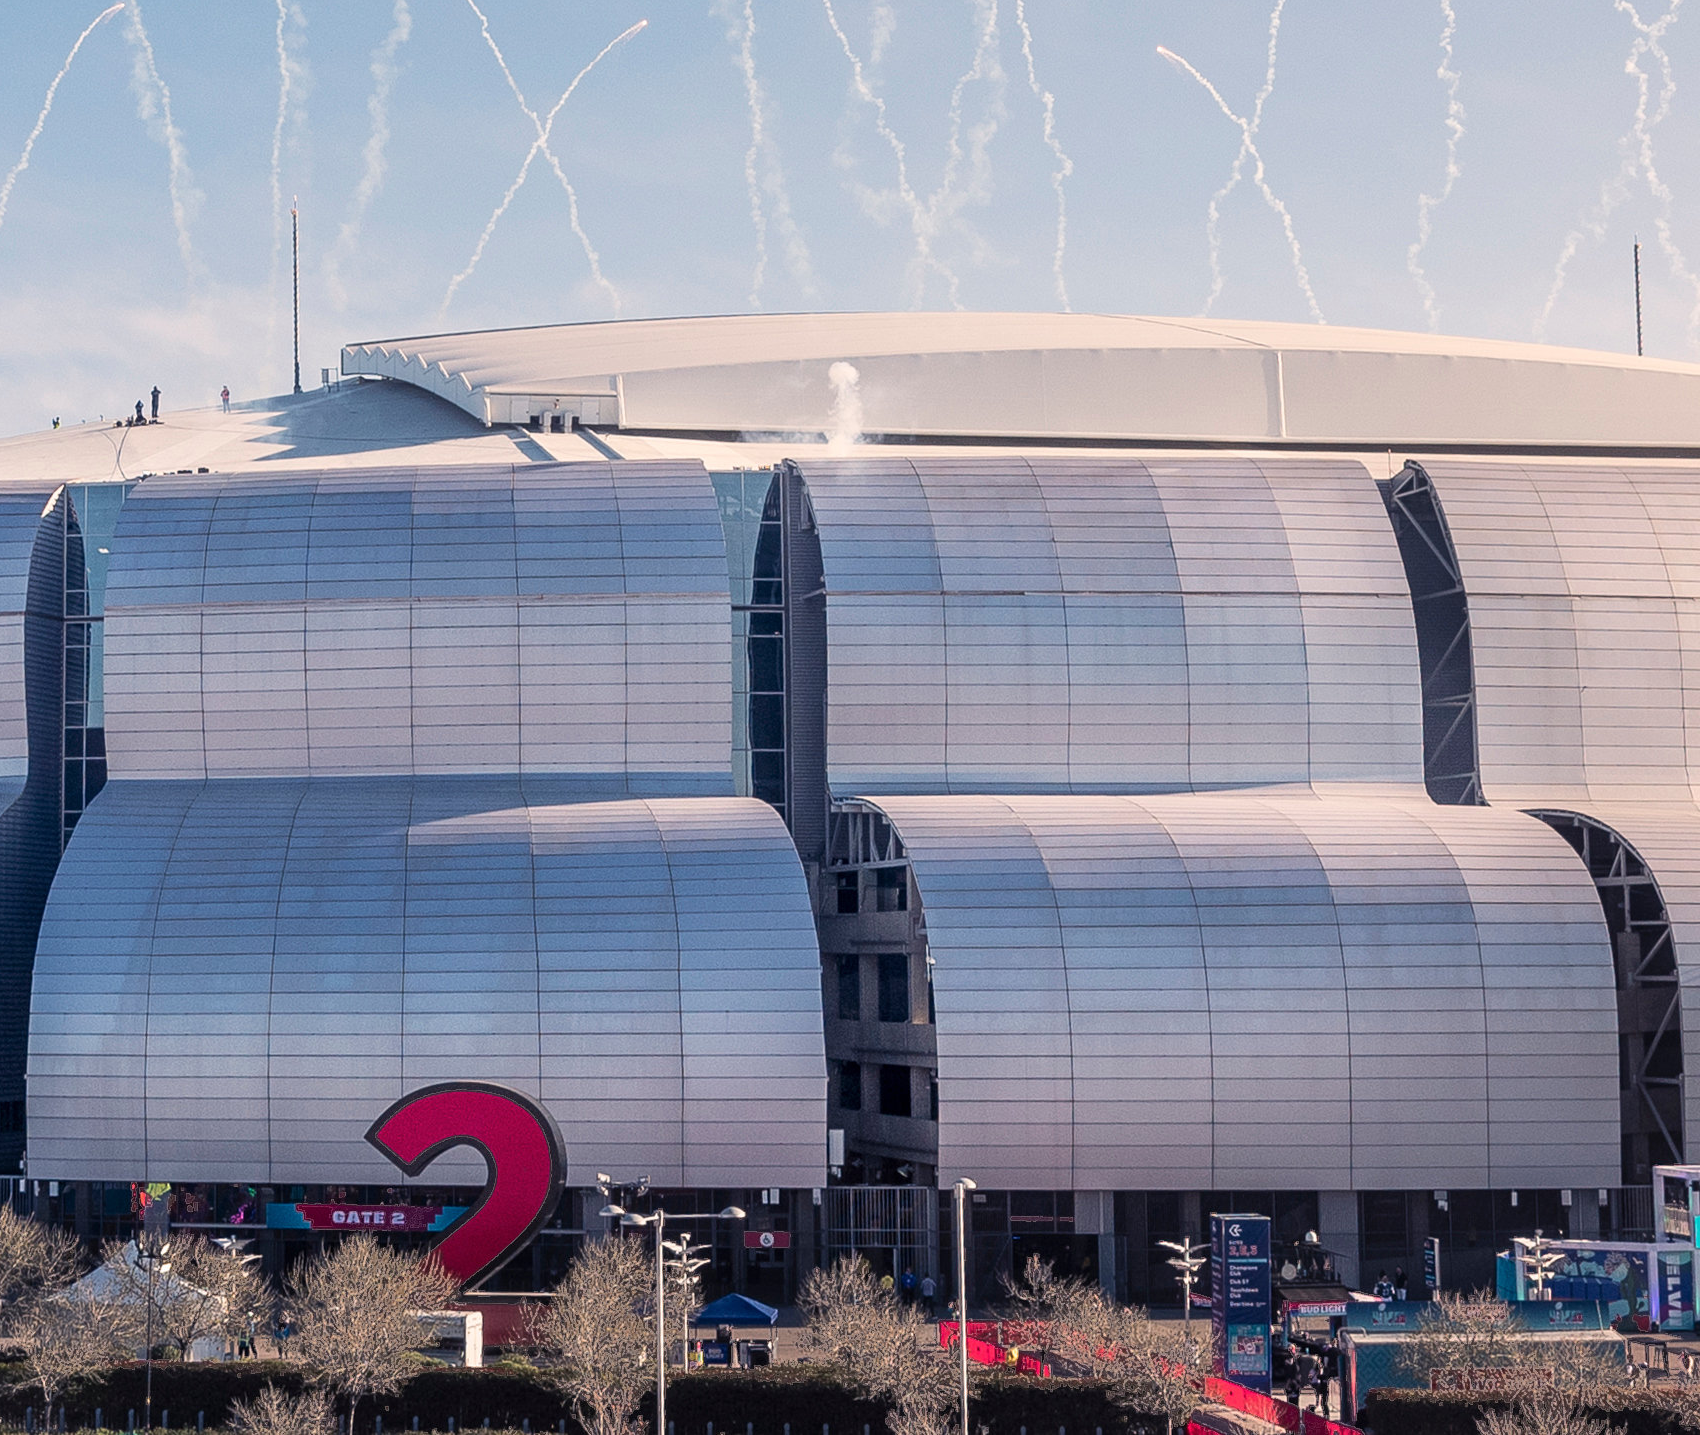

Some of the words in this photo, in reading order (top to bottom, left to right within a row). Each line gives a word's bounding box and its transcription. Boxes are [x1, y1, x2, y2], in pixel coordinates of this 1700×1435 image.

[332, 1210, 385, 1224] GATE
[392, 1211, 405, 1224] 2
[363, 1080, 568, 1348] 2
[1300, 1306, 1320, 1314] BUD
[1321, 1304, 1347, 1314] LIGHT
